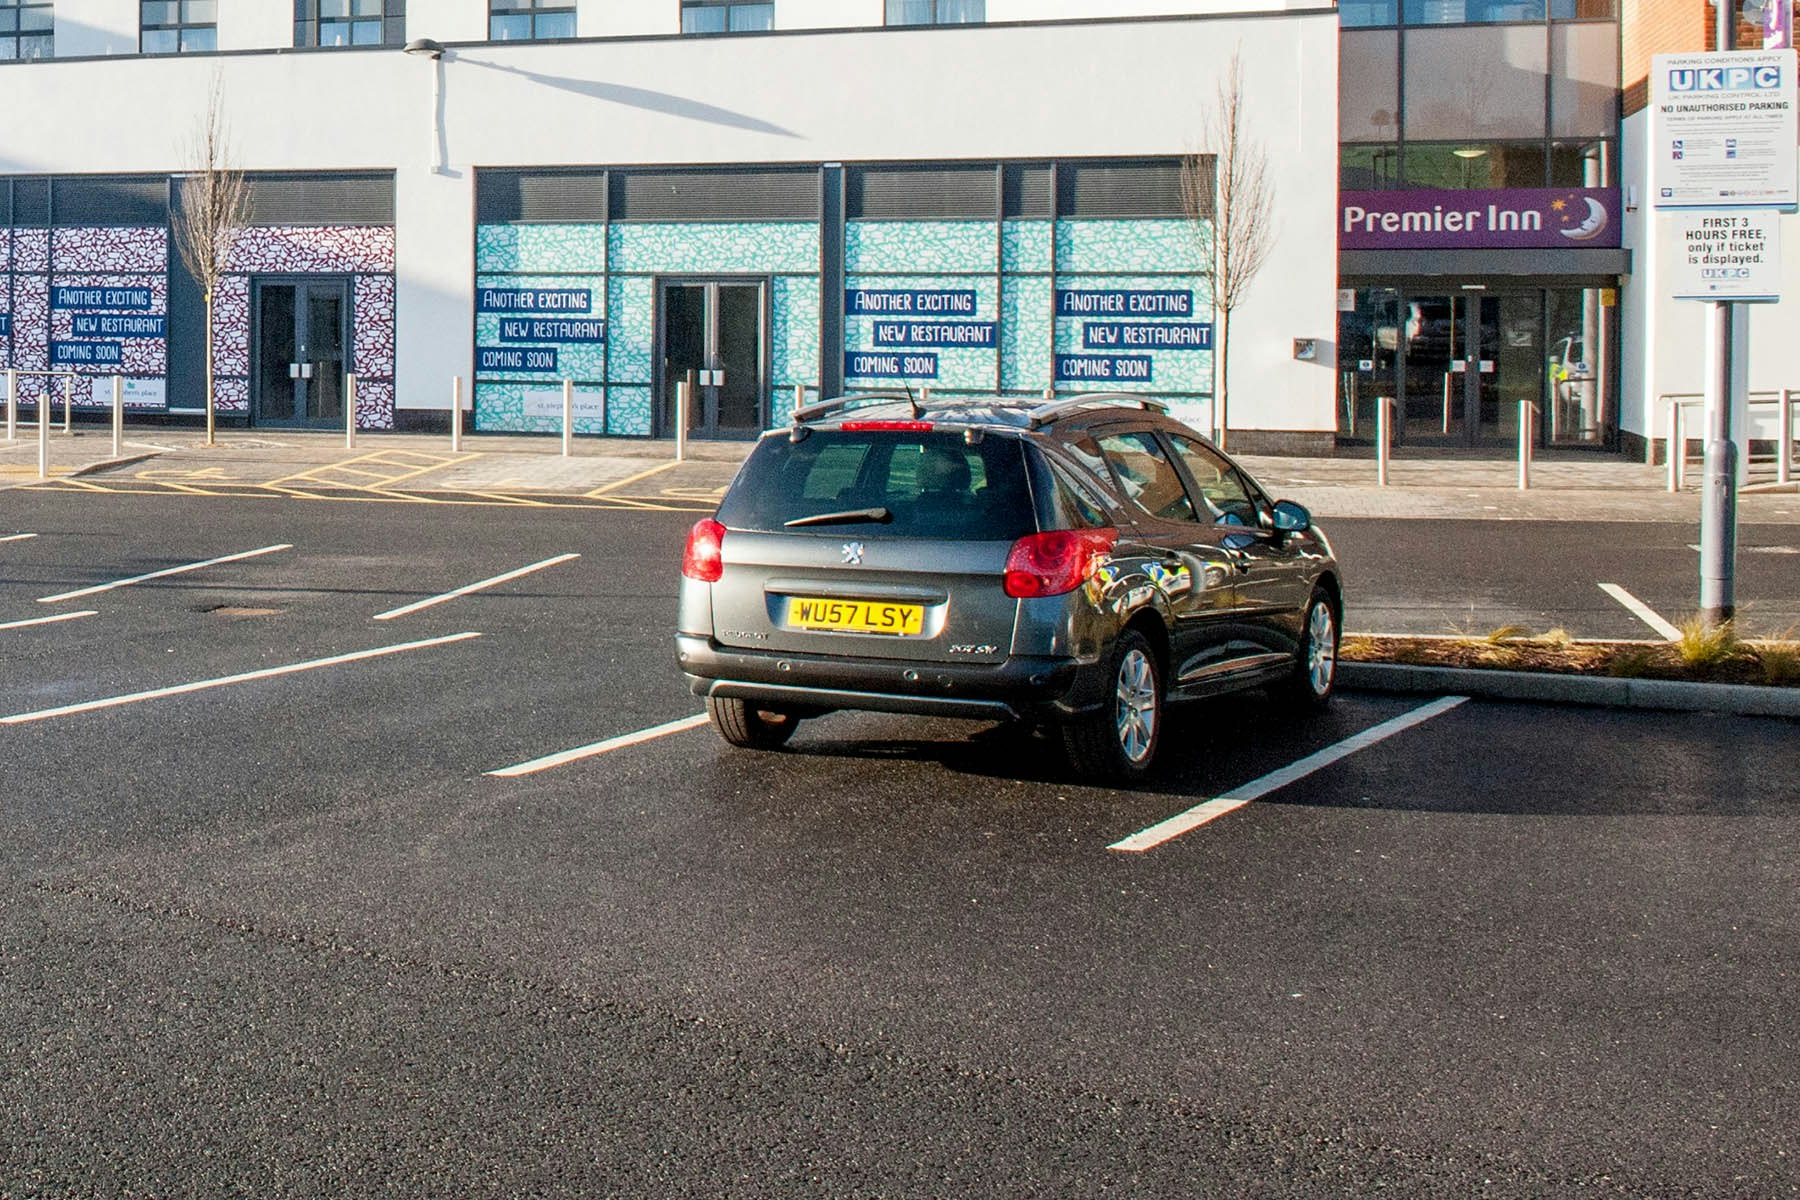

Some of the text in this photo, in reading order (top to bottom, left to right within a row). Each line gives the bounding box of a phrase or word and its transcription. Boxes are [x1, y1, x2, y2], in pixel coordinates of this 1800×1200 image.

[1669, 66, 1780, 92] UKPC
[1661, 101, 1789, 113] NO UNAUTHORISED PARKING
[1344, 205, 1541, 233] Premier Inn
[1703, 217, 1749, 228] FIRST 3
[1686, 229, 1767, 241] HOURS FREE,
[1688, 241, 1765, 253] only if ticket
[1688, 253, 1764, 265] is displayed.
[58, 288, 147, 305] ANOTHER EXCITING
[483, 290, 587, 308] ANOTHER EXCITING
[854, 291, 972, 311] ANOTHER EXCITING
[1063, 292, 1188, 312] ANOTHER EXCITING
[76, 318, 163, 333] NEW RESTAURANT
[504, 322, 604, 338] NEW RESTAURANT
[879, 325, 993, 343] NEW RESTAURANT
[1089, 326, 1210, 345] NEW RESTAURANT
[57, 345, 118, 360] COMING SOON
[482, 352, 554, 368] COMING SOON
[854, 356, 935, 374] COMING SOON
[1062, 359, 1148, 377] COMING SOON
[799, 604, 913, 628] WU57 LSY
